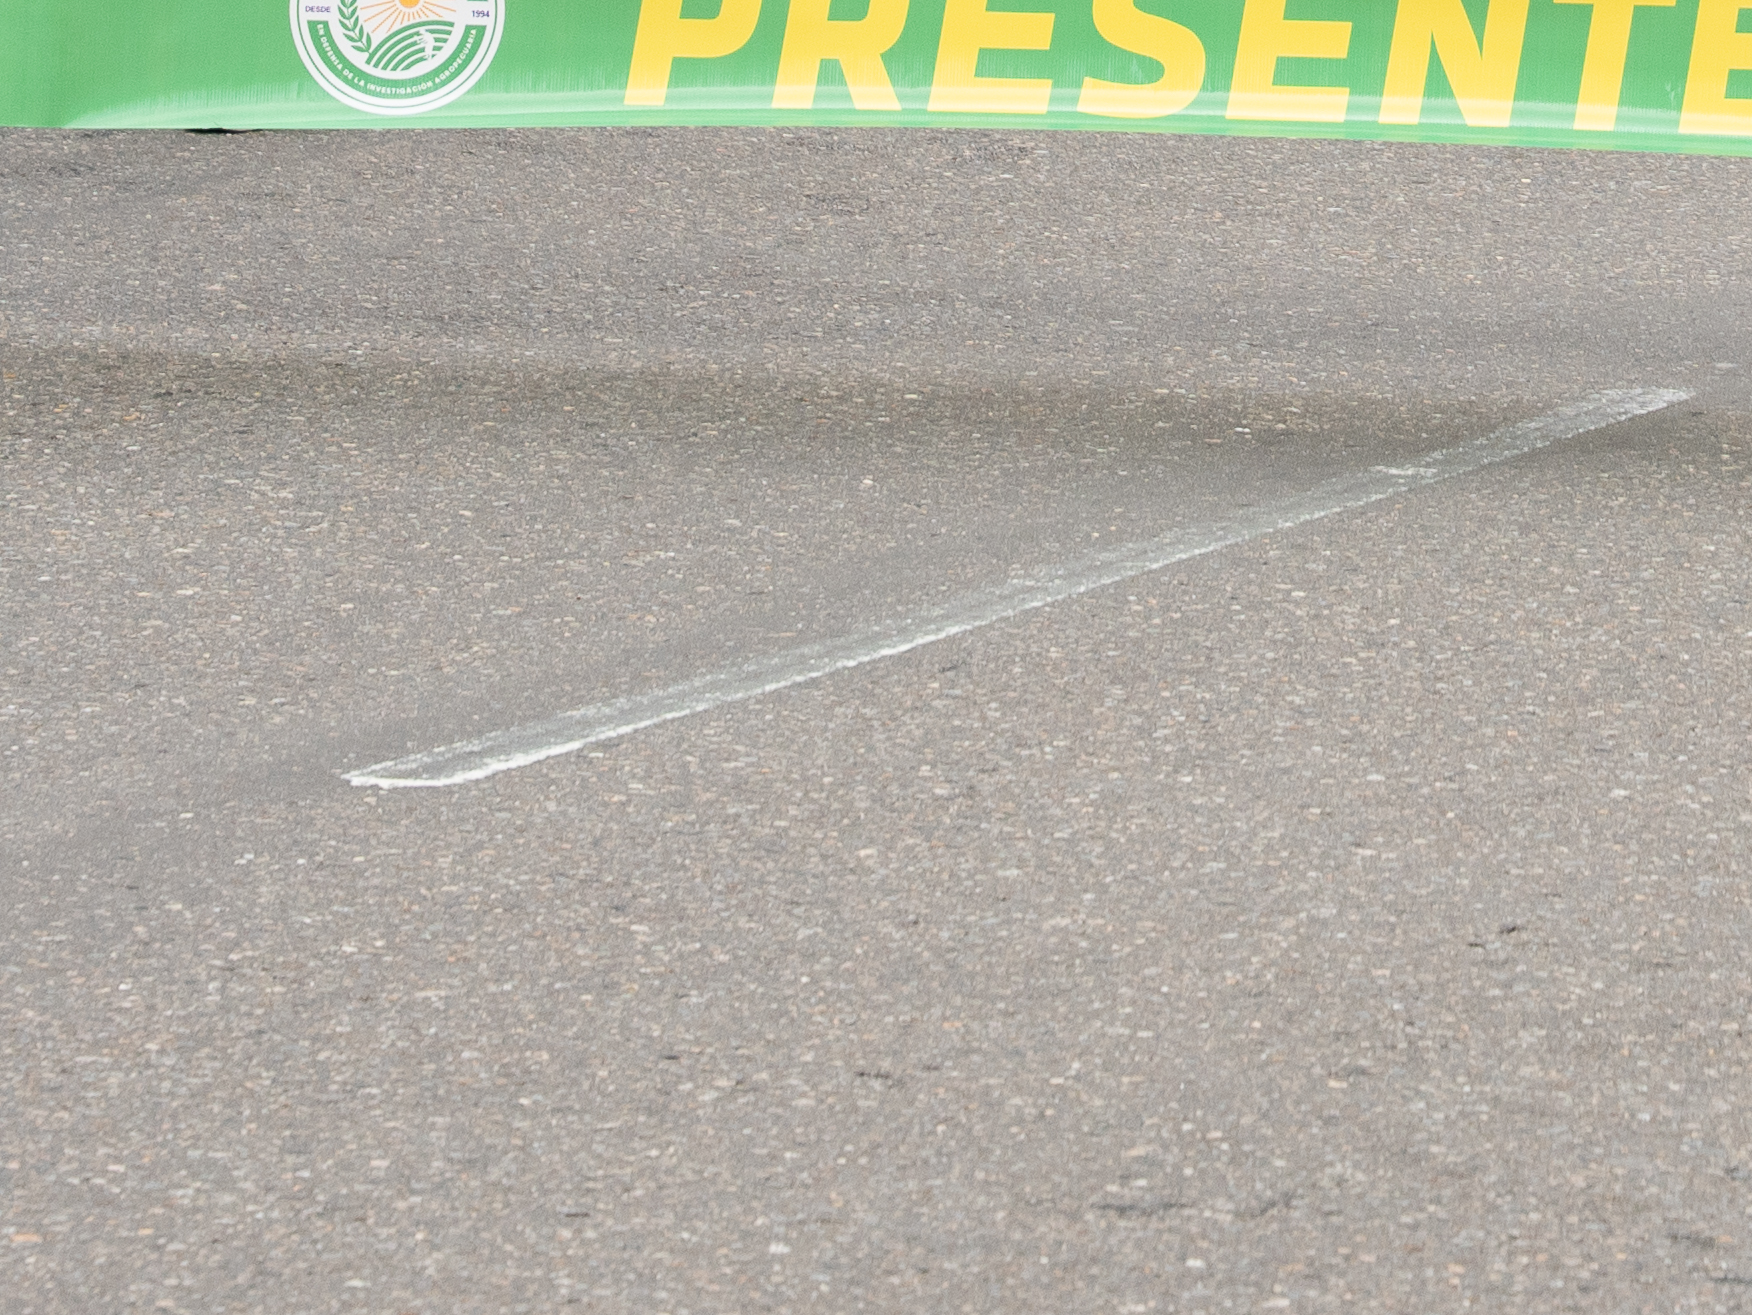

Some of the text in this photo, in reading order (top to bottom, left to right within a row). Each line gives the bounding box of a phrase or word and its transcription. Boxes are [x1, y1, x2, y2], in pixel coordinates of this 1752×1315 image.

[304, 4, 332, 14] DESDE
[471, 9, 491, 19] 1994
[342, 68, 355, 81] DE
[353, 76, 366, 88] LA
[366, 79, 435, 95] INVESTIGACIÓN
[433, 28, 478, 85] AGROPECUARIA
